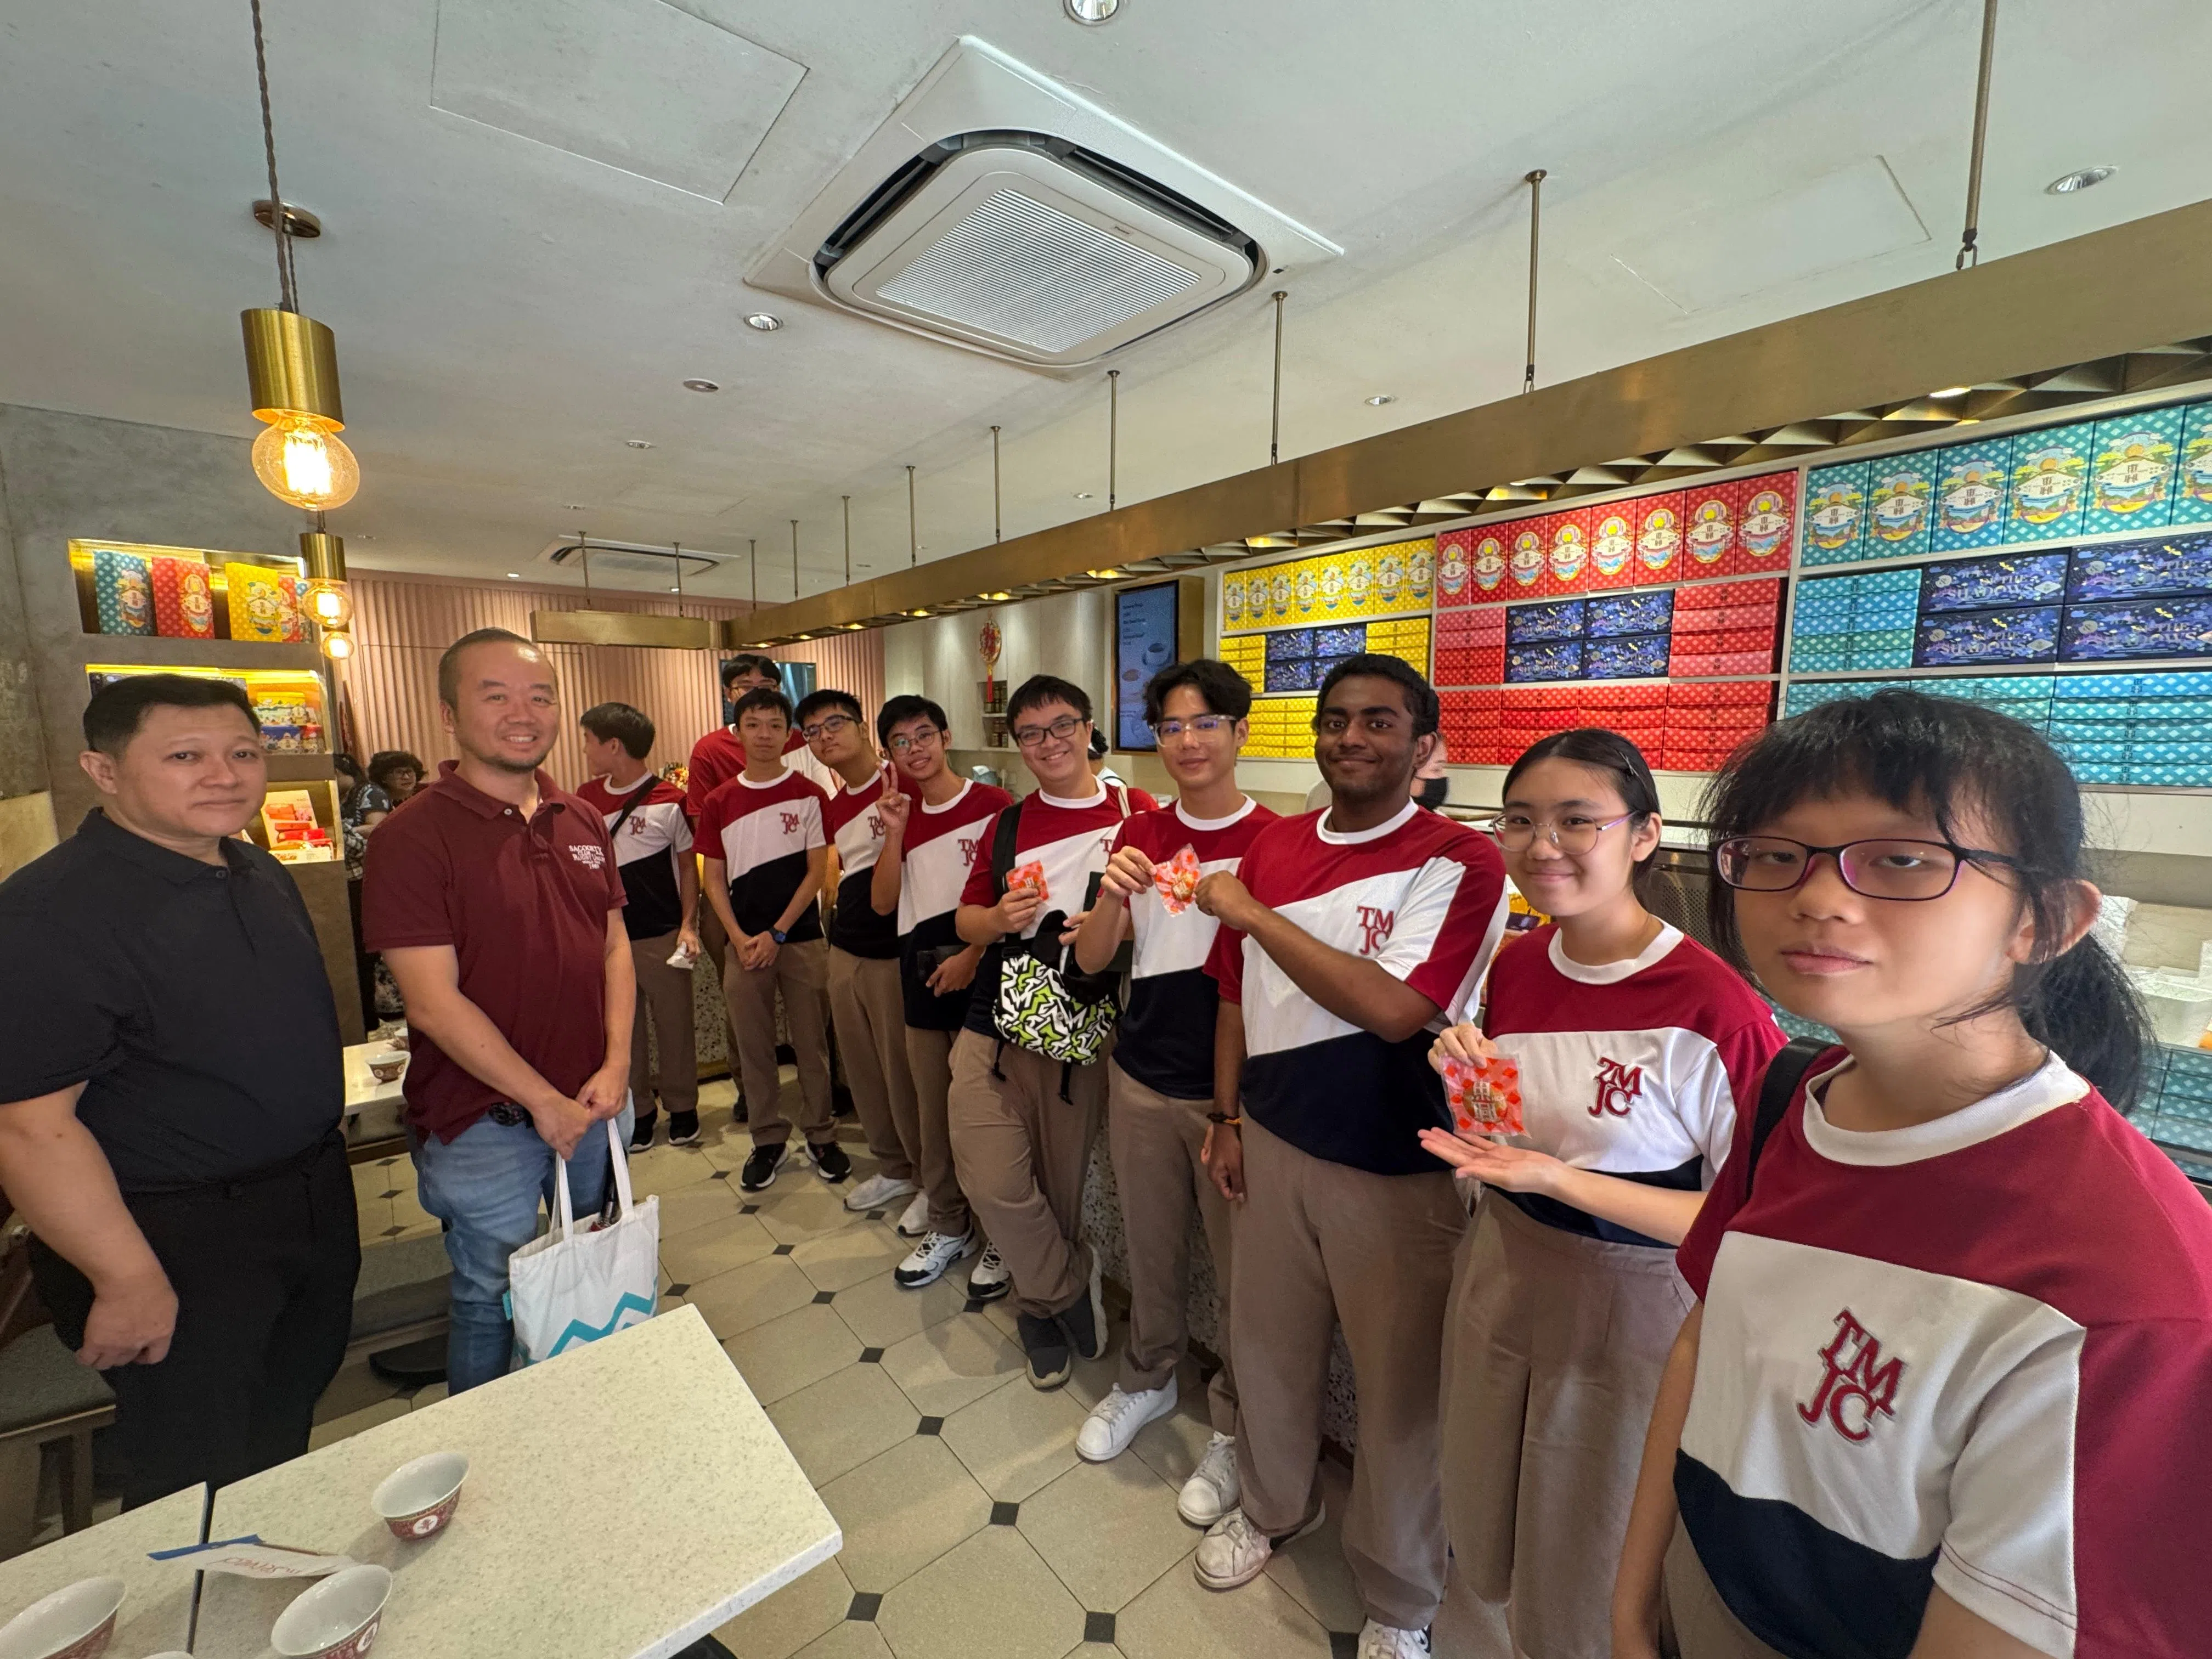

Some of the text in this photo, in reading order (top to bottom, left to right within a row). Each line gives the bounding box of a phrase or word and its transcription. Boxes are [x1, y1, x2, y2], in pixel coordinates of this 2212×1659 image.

[629, 815, 646, 828] TM
[630, 823, 643, 835] JC
[780, 812, 799, 825] TM
[783, 822, 797, 834] JC
[871, 825, 885, 839] JC
[1357, 905, 1394, 934] TM
[1359, 927, 1389, 955] JC
[1597, 1057, 1643, 1096] TM
[1587, 1076, 1633, 1117] JC
[1819, 1308, 1906, 1417] TM
[1796, 1370, 1880, 1443] JC
